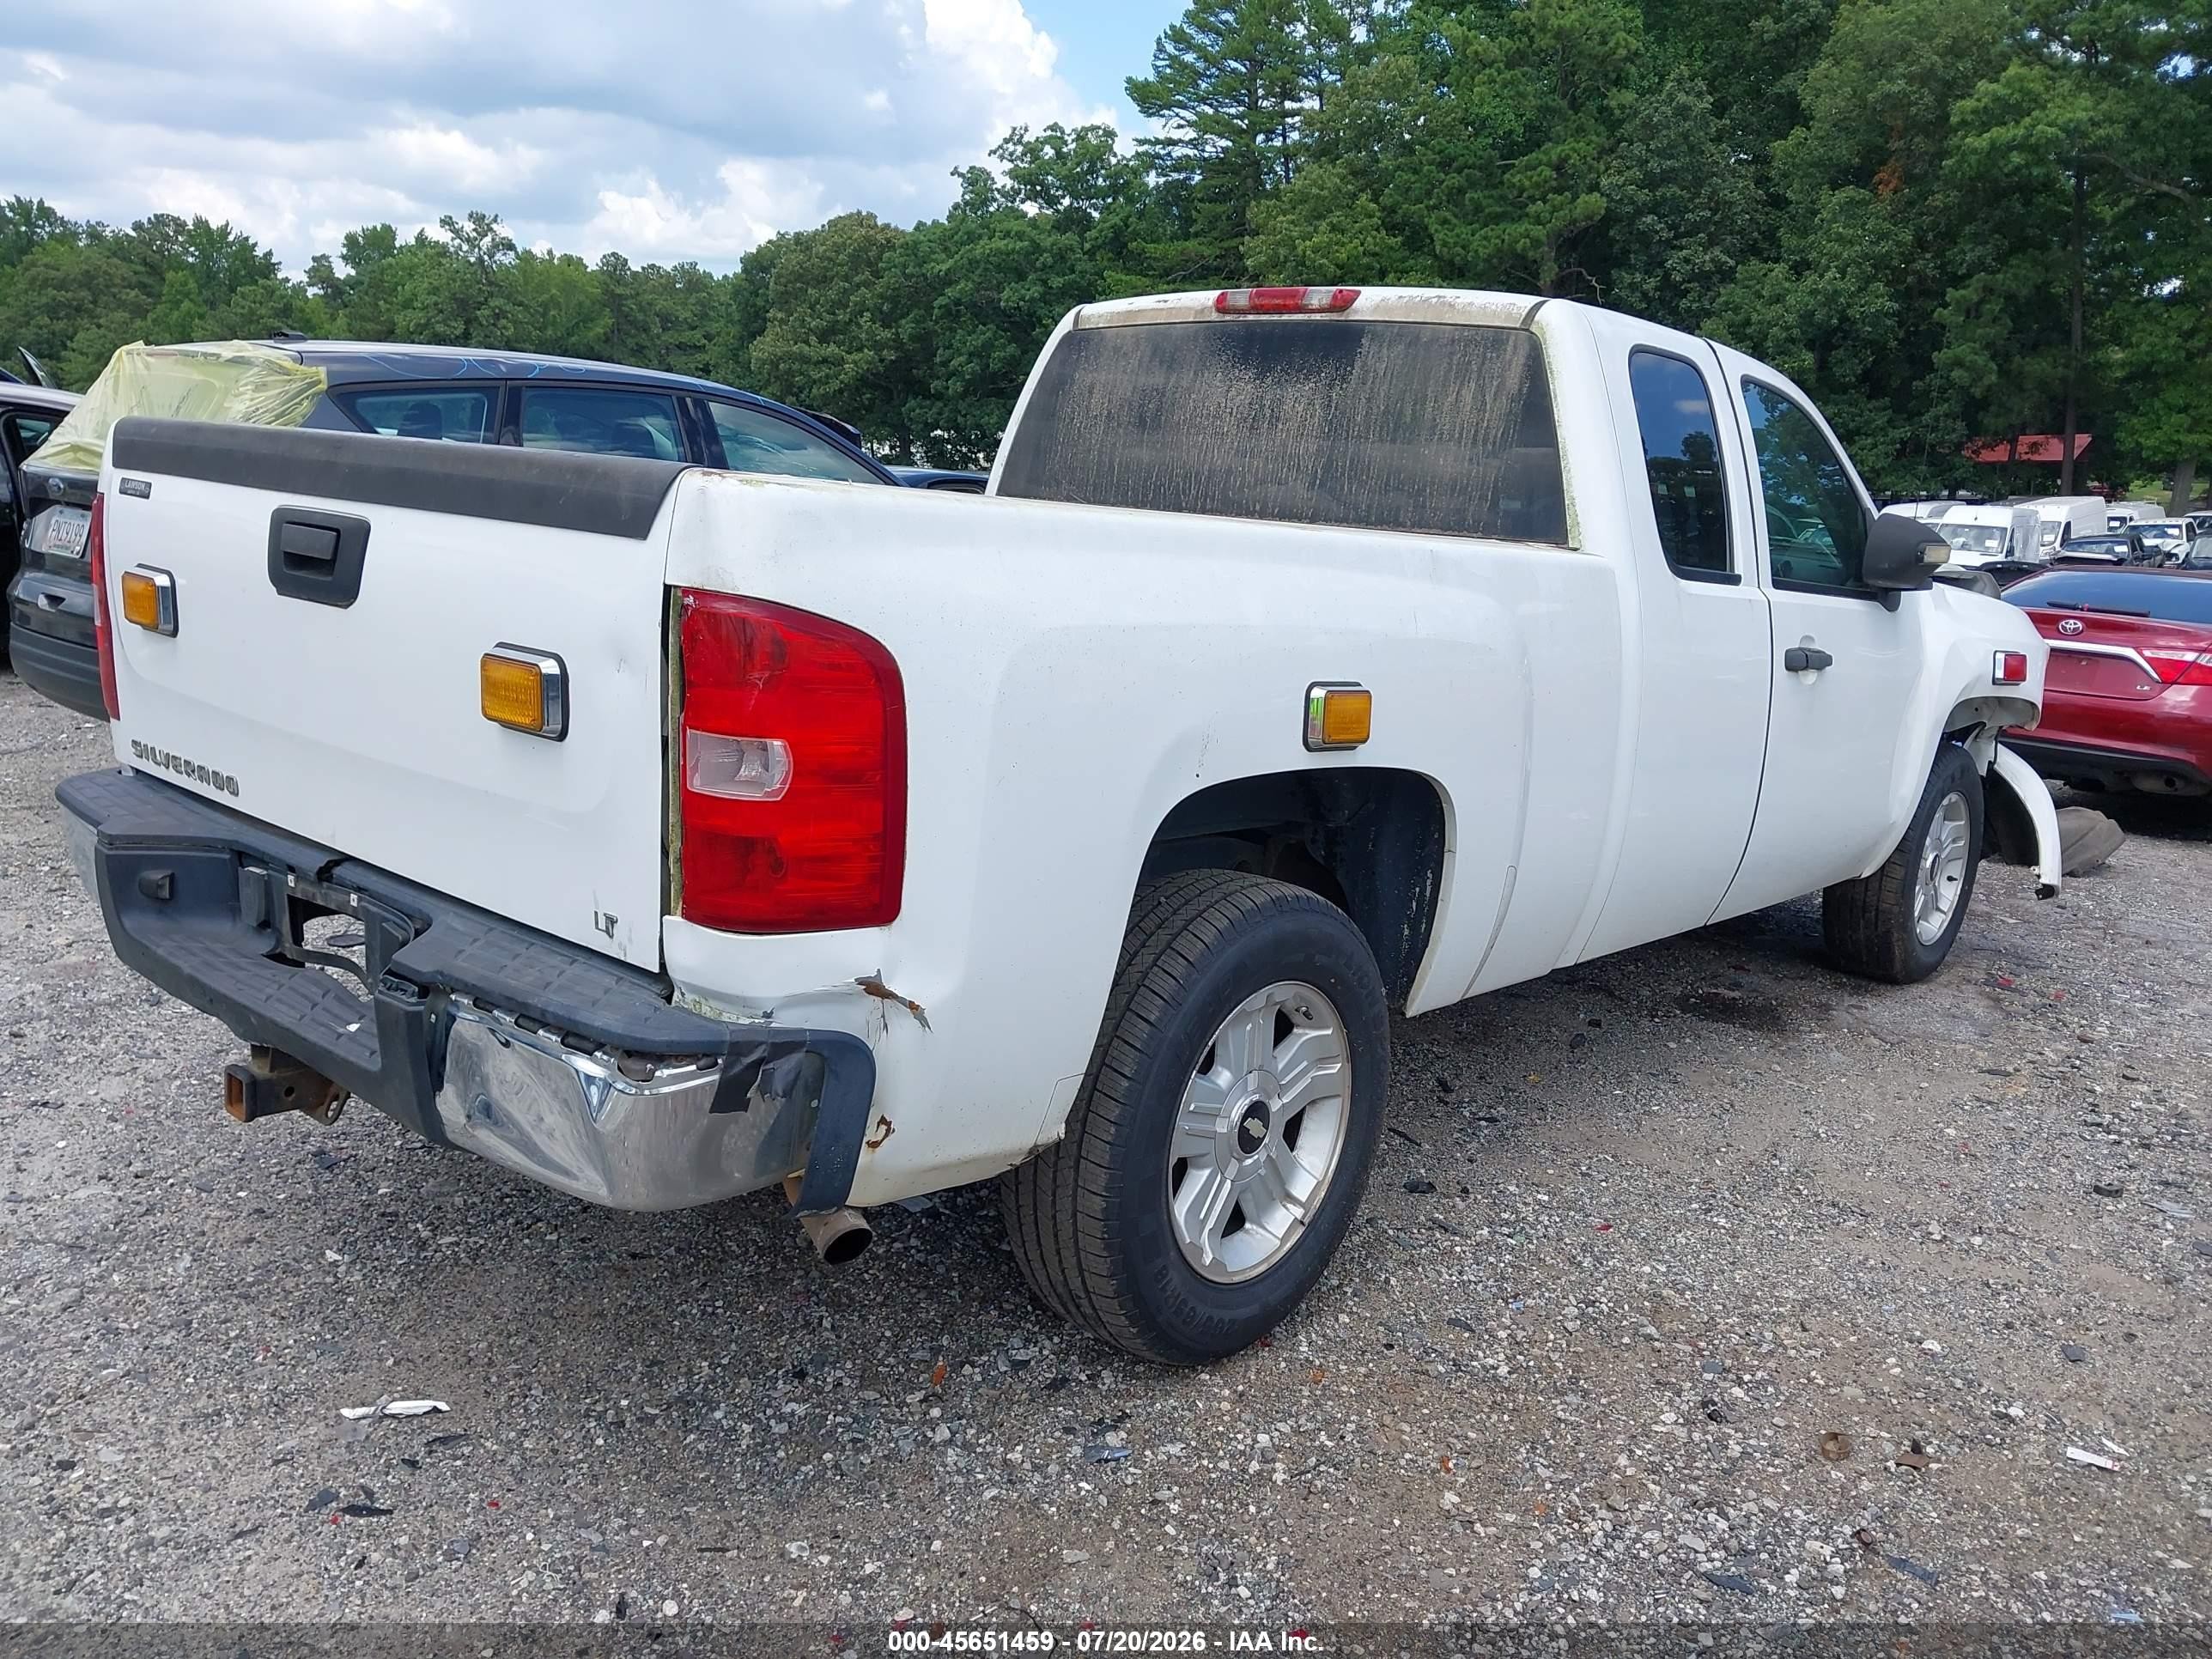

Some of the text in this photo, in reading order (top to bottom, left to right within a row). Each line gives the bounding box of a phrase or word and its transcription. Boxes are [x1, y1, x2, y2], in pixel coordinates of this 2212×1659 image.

[125, 479, 146, 491] LAWSON
[131, 738, 240, 798] SILVERADO
[593, 910, 618, 939] LT
